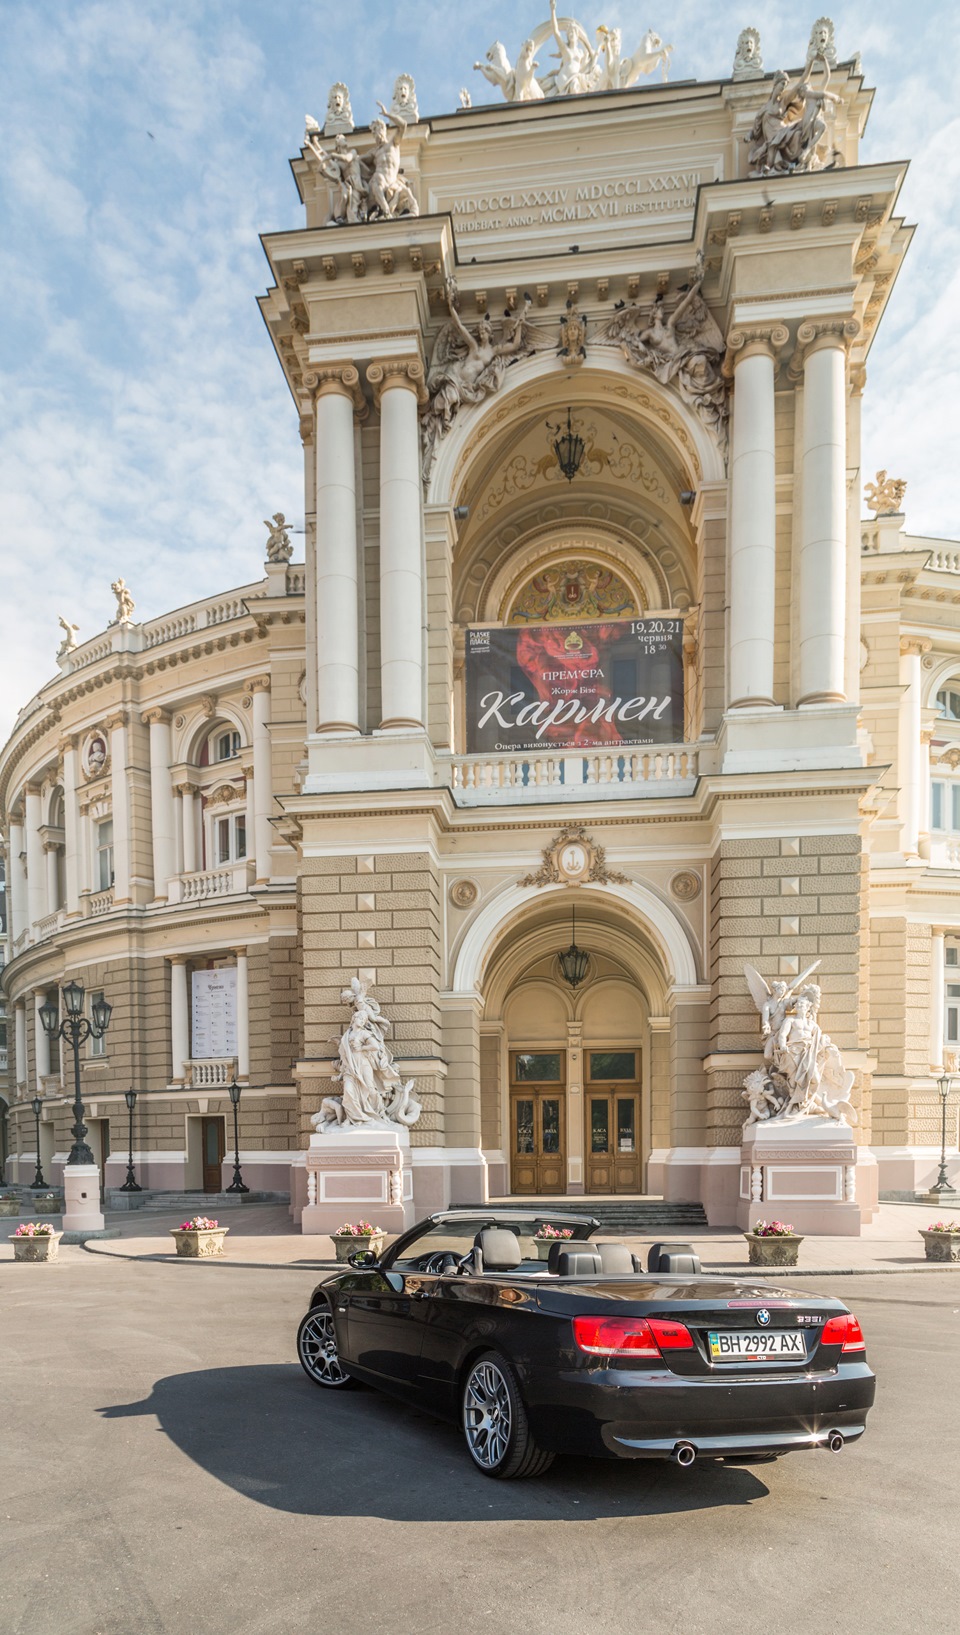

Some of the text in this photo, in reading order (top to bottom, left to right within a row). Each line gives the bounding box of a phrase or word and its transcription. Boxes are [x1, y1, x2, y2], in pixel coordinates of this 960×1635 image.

[452, 188, 569, 215] MDCCCLXXXIV
[638, 635, 673, 645] червня
[644, 645, 656, 655] 18
[477, 690, 672, 740] Кармен
[494, 742, 521, 752] Опера
[604, 738, 654, 747] антрактами
[720, 1334, 800, 1353] BH 2992 AX
